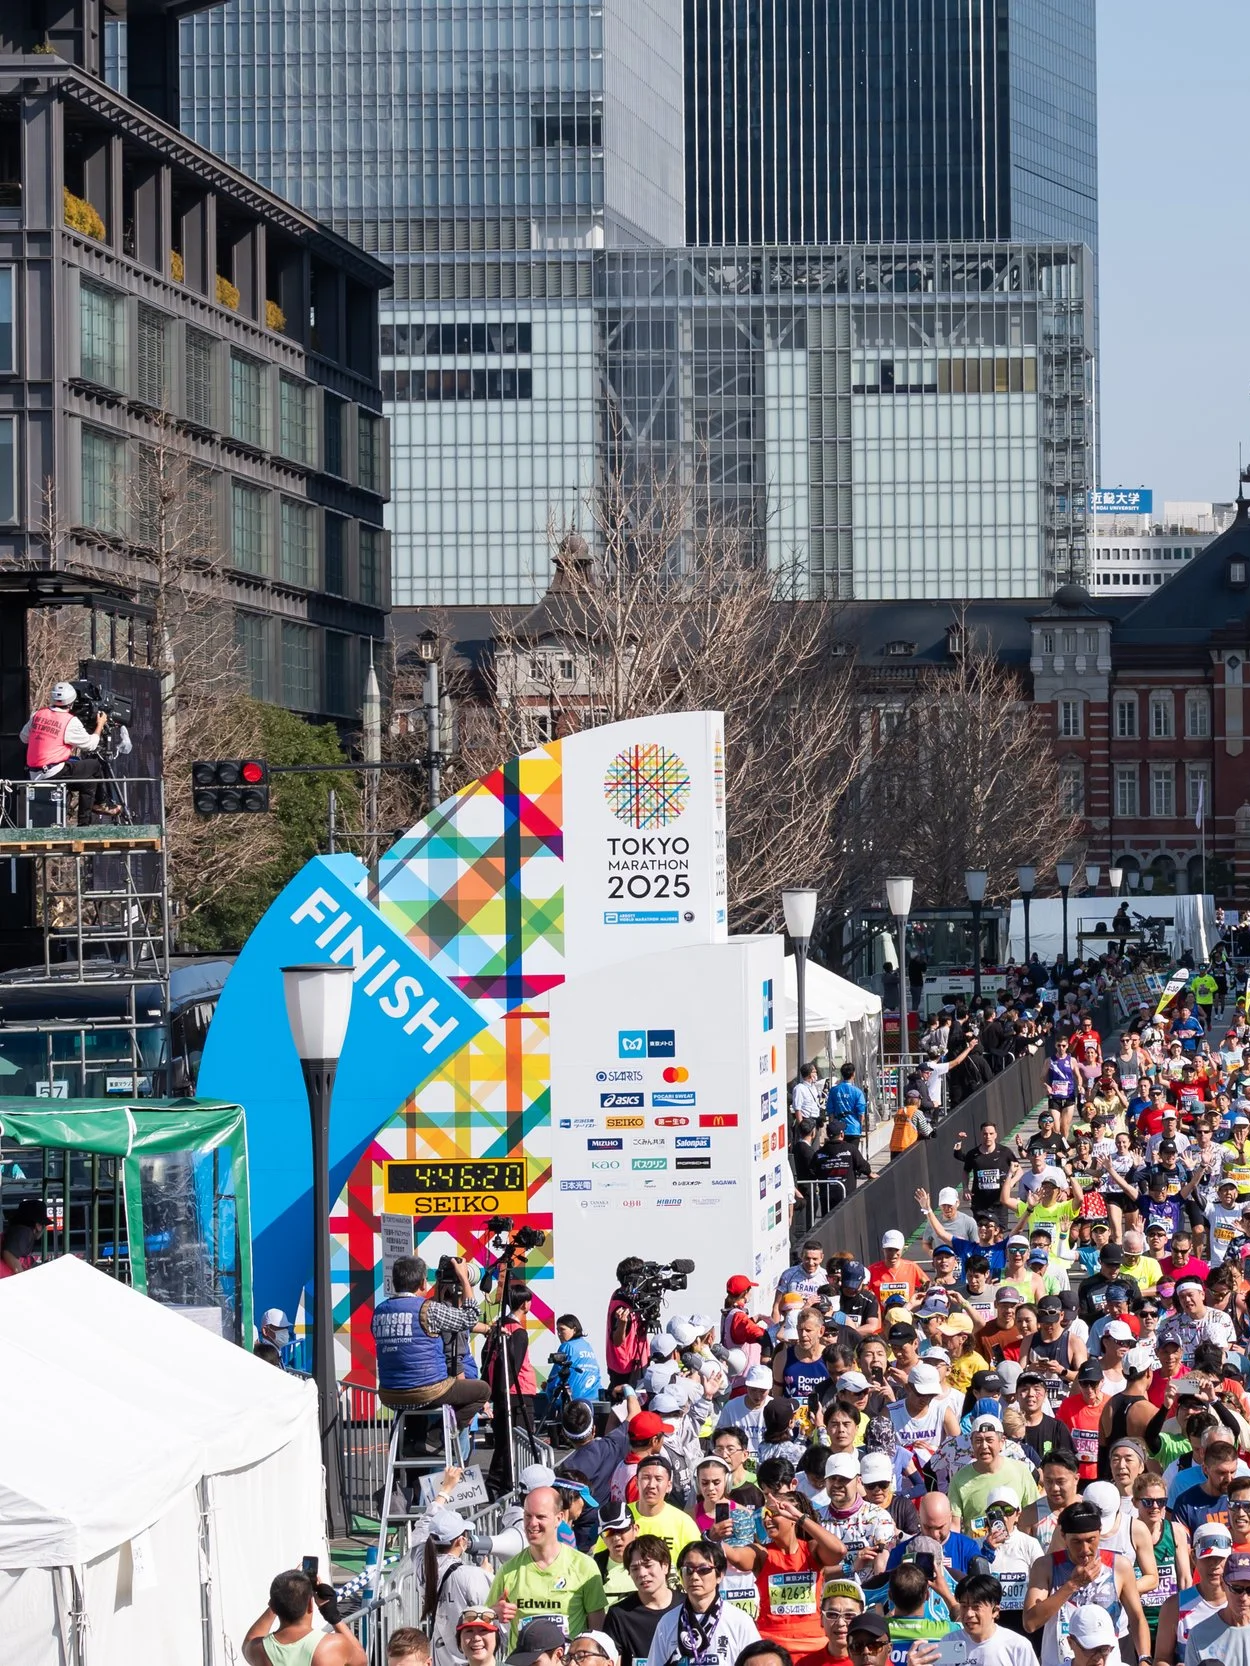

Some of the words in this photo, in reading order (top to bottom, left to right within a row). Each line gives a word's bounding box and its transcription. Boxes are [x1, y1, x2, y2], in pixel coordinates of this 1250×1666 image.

[607, 837, 689, 855] TOKYO
[609, 860, 689, 871] MARATHON
[607, 874, 690, 899] 2025
[289, 886, 460, 1055] FINISH
[606, 1119, 644, 1127] SEIKO
[676, 1139, 707, 1148] Salonpas
[633, 1159, 666, 1169] バスクリン
[415, 1165, 521, 1189] 4:46:20
[561, 1181, 591, 1190] 日本光電
[415, 1195, 499, 1213] SEIKO
[900, 1430, 936, 1440] TAIWAN
[516, 1598, 561, 1609] Edwin
